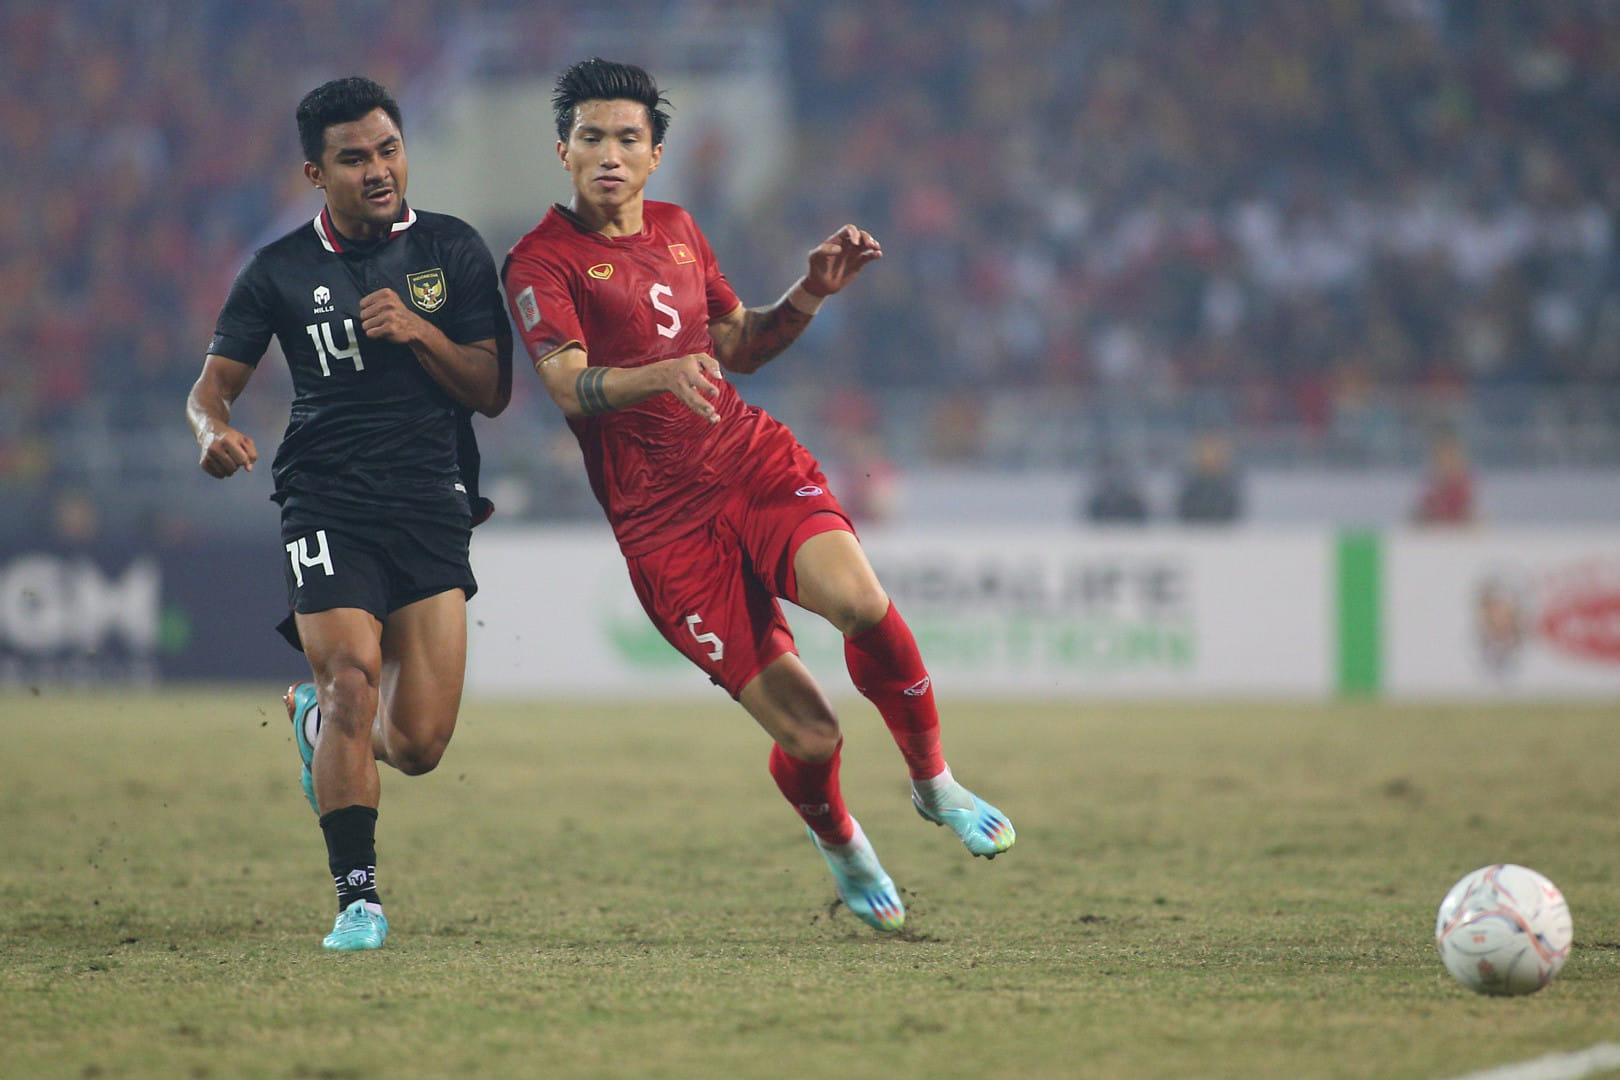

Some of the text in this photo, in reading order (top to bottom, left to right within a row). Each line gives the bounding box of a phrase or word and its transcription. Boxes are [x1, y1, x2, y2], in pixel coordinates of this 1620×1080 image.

[313, 305, 334, 314] MILLS
[306, 318, 365, 377] 14
[286, 530, 335, 588] 14
[686, 613, 724, 662] 5
